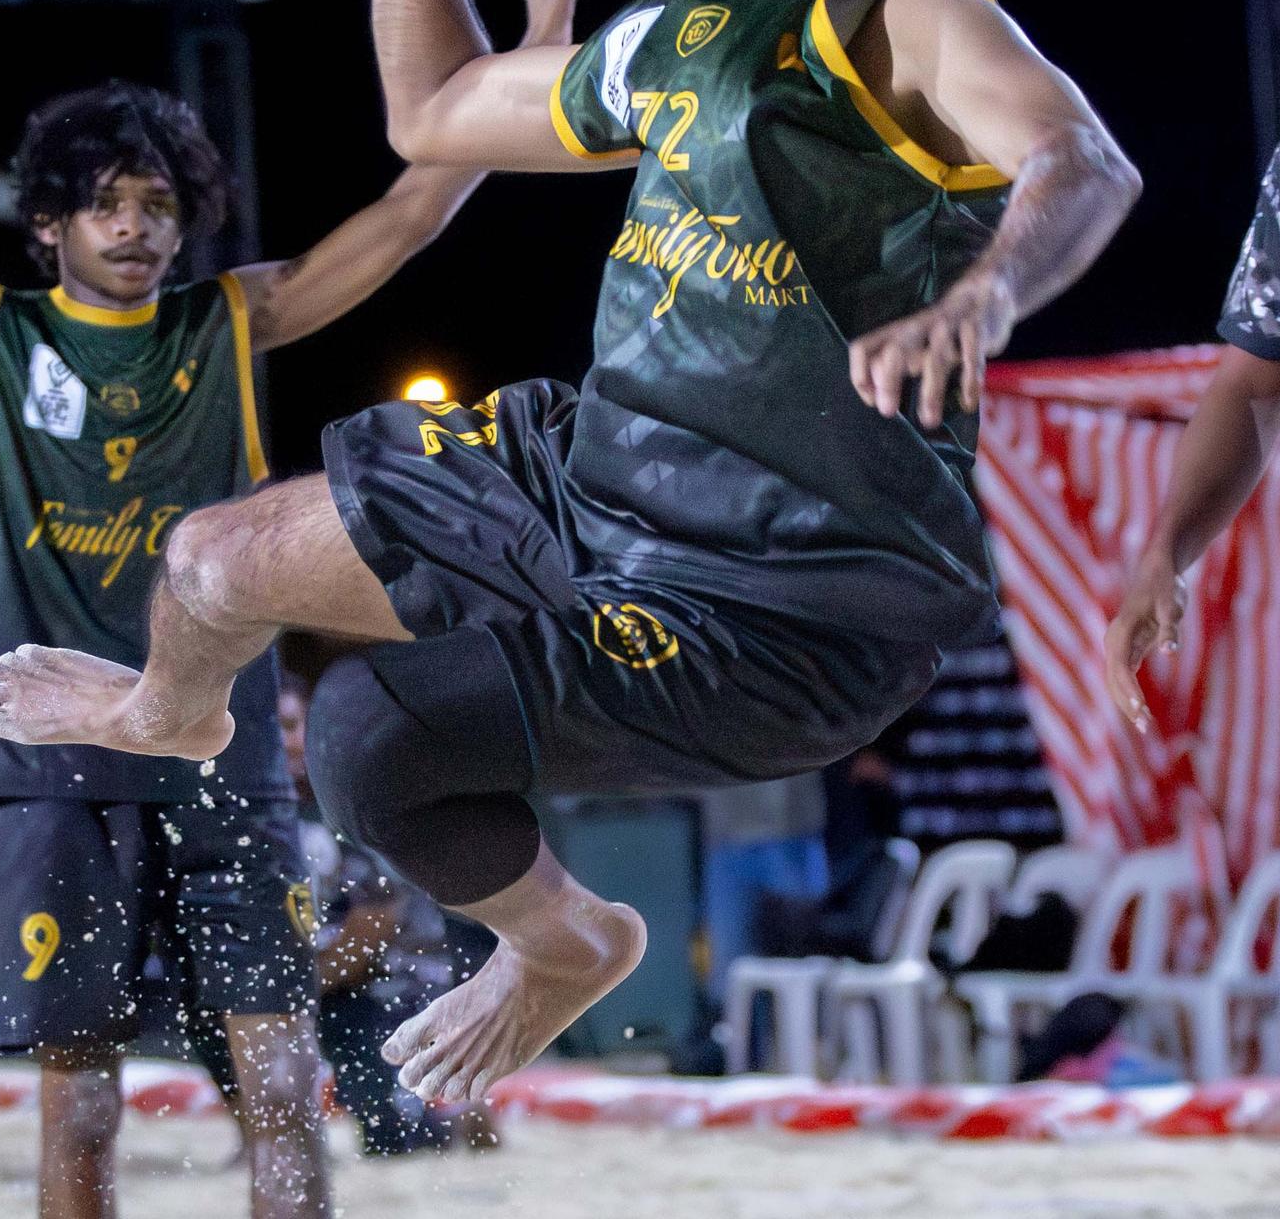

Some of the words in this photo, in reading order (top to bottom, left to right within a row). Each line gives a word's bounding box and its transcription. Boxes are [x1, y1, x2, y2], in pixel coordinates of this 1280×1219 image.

[631, 90, 700, 171] 72
[609, 207, 712, 319] amily
[744, 285, 809, 307] MART
[103, 436, 138, 482] 9
[22, 912, 60, 981] 9
